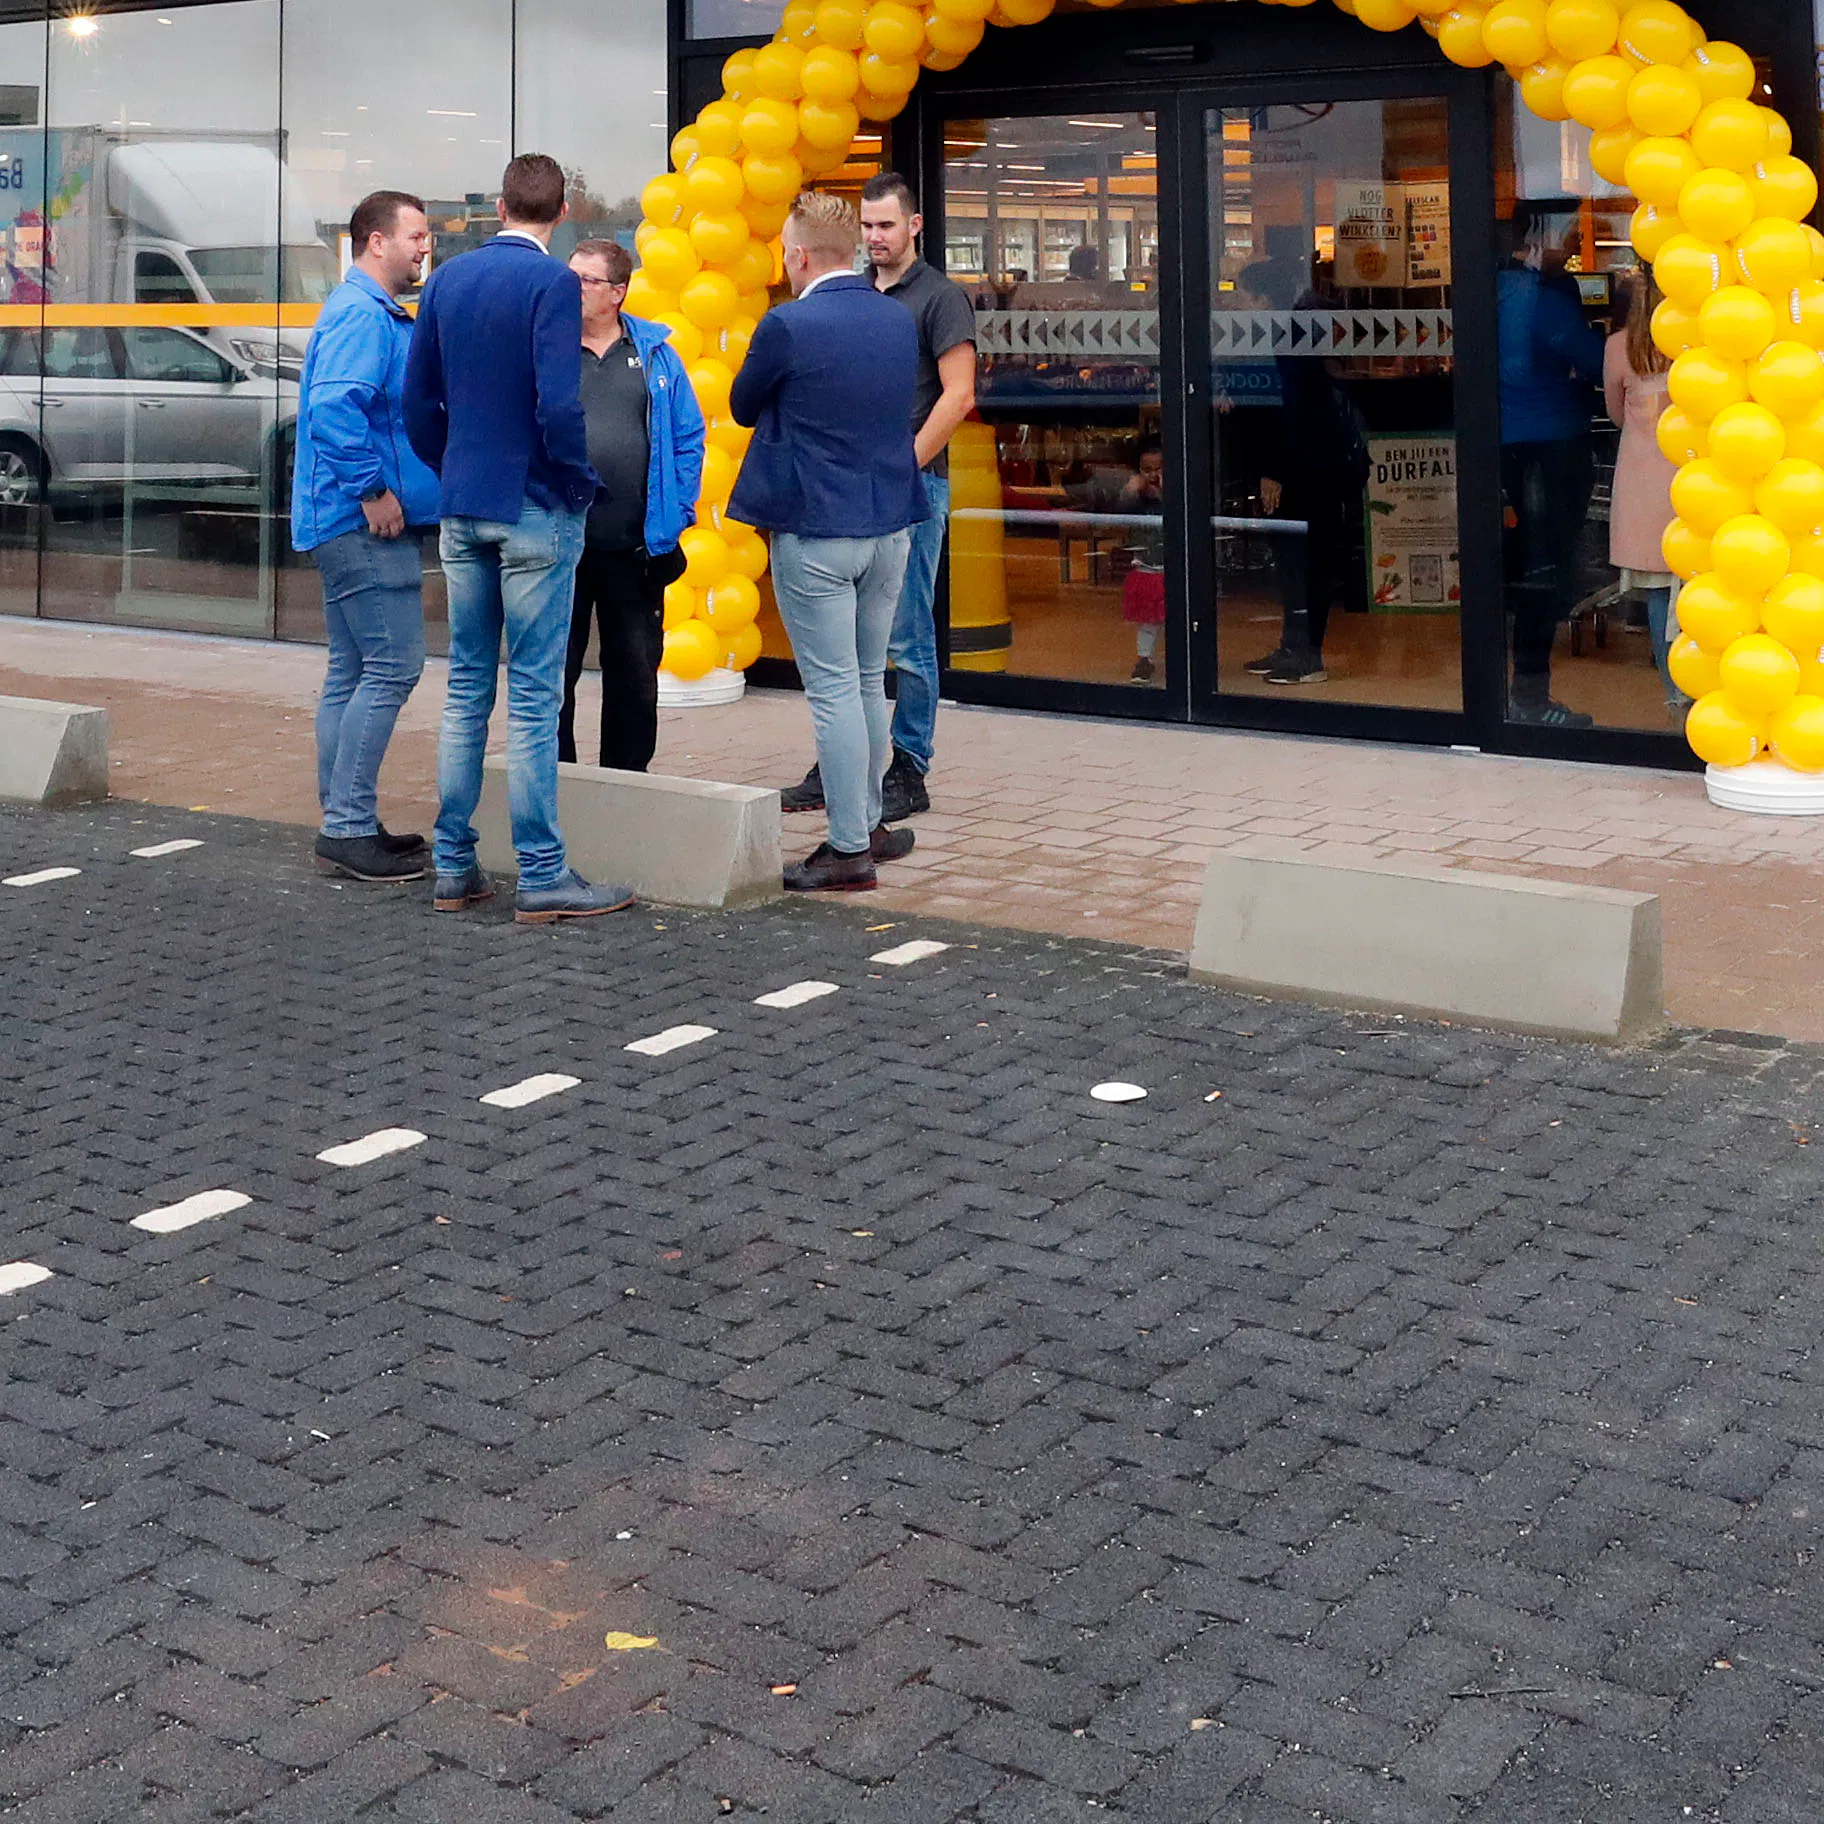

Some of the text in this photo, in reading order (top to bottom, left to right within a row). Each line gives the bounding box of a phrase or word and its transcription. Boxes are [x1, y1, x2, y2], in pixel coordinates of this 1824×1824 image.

[1359, 190, 1382, 202] NOG
[1347, 208, 1394, 220] VLOTTER
[1339, 224, 1402, 237] WINKELEN?
[1385, 449, 1407, 462] BEN
